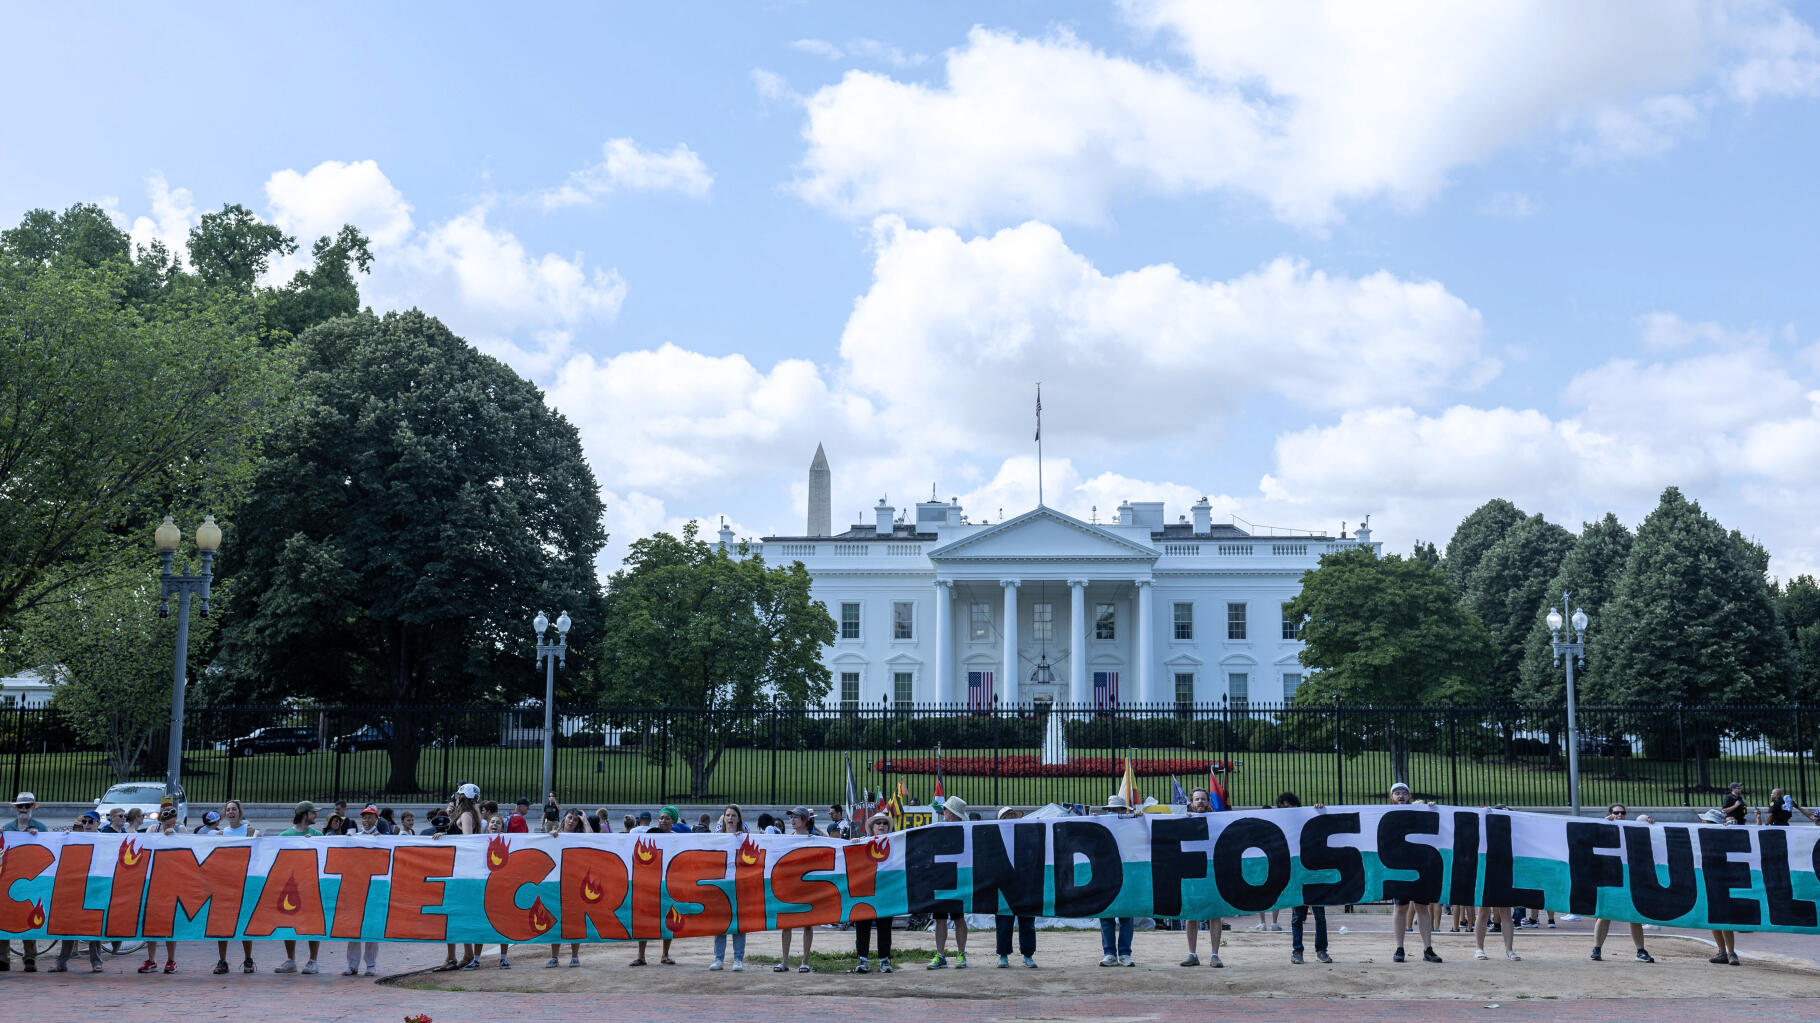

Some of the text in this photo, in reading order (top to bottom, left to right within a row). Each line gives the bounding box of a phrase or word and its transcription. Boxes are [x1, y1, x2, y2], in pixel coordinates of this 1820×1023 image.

[0, 810, 1820, 941] CLIMATE CRISIS! END FOSSIL FUEL
